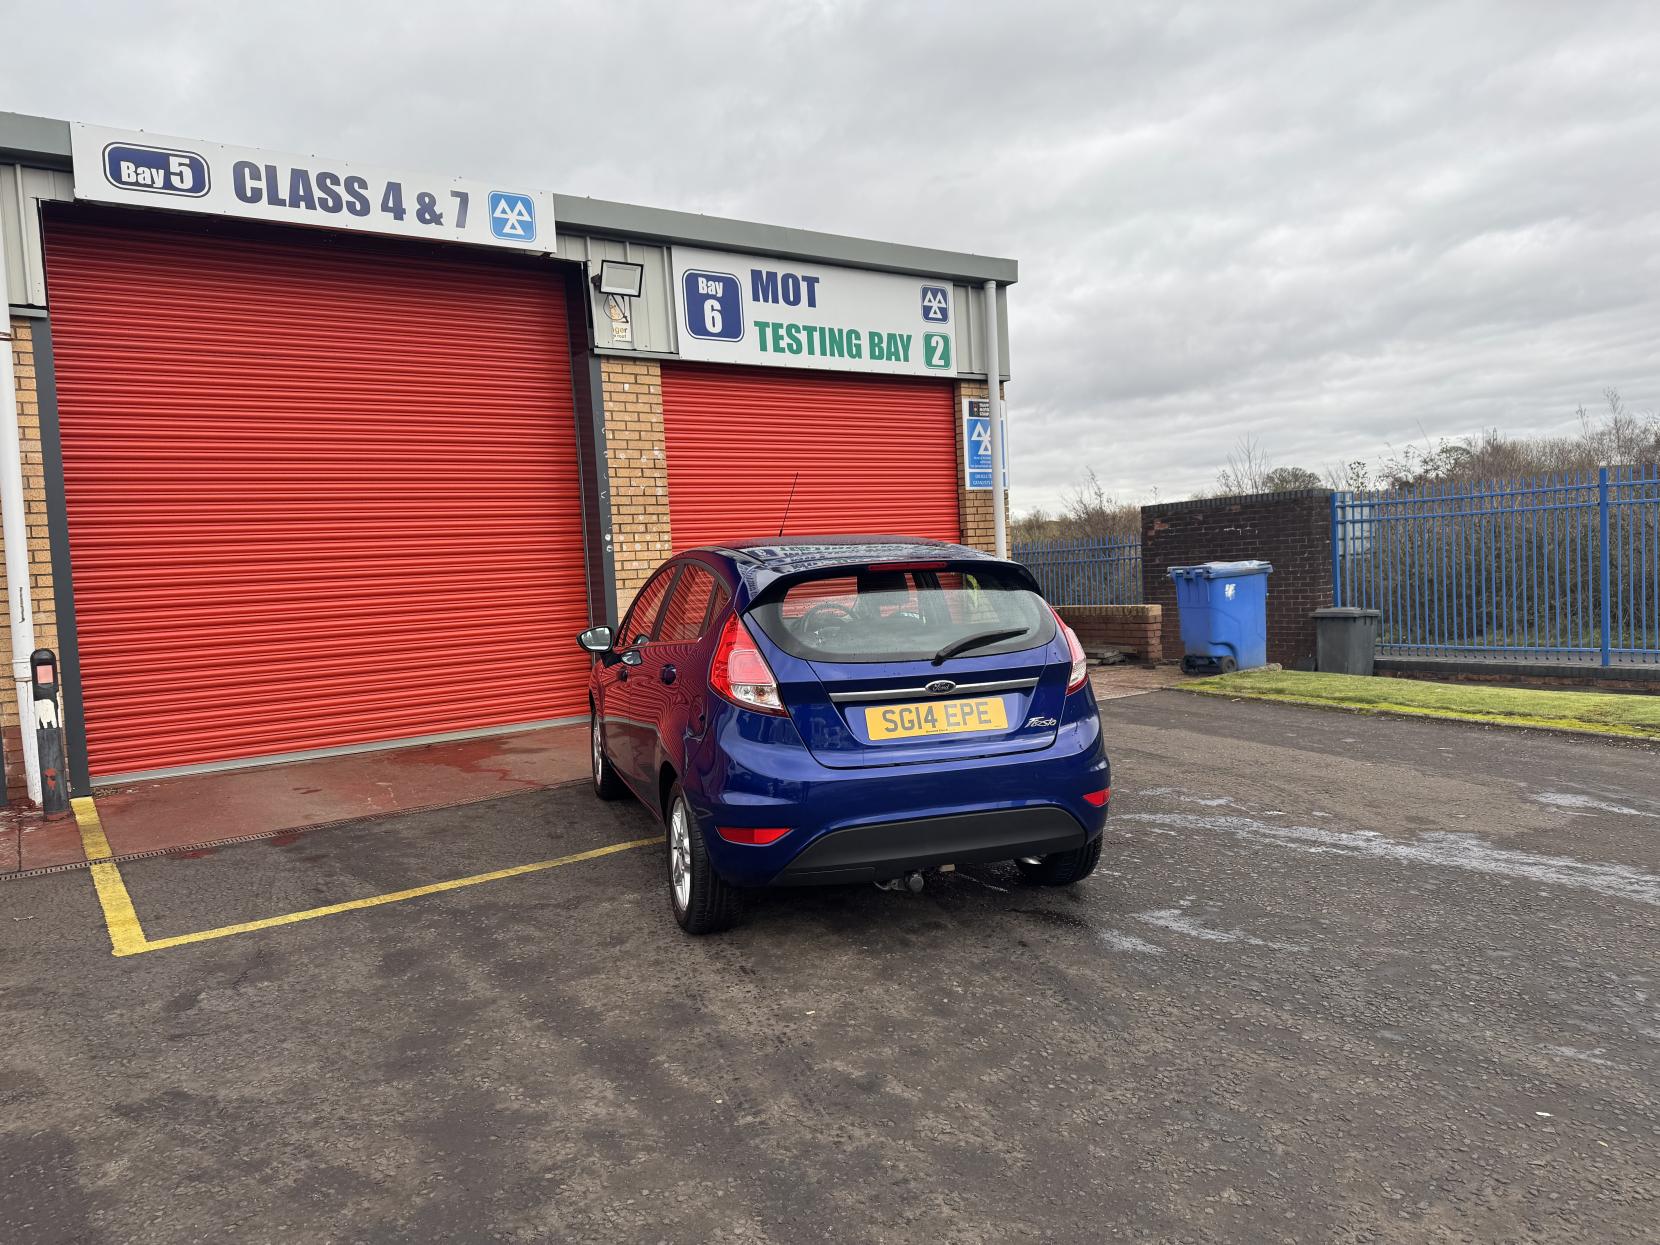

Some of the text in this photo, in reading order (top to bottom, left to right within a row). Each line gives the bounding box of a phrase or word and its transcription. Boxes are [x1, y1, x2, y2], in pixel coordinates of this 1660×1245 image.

[120, 156, 193, 190] Bay 5
[232, 160, 469, 229] CLASS 4 & 7
[698, 277, 723, 298] Bay
[750, 269, 820, 308] MOT
[703, 299, 722, 334] 6
[754, 320, 913, 362] TESTING BAY
[930, 335, 945, 366] 2
[882, 701, 992, 733] SG14 EPE
